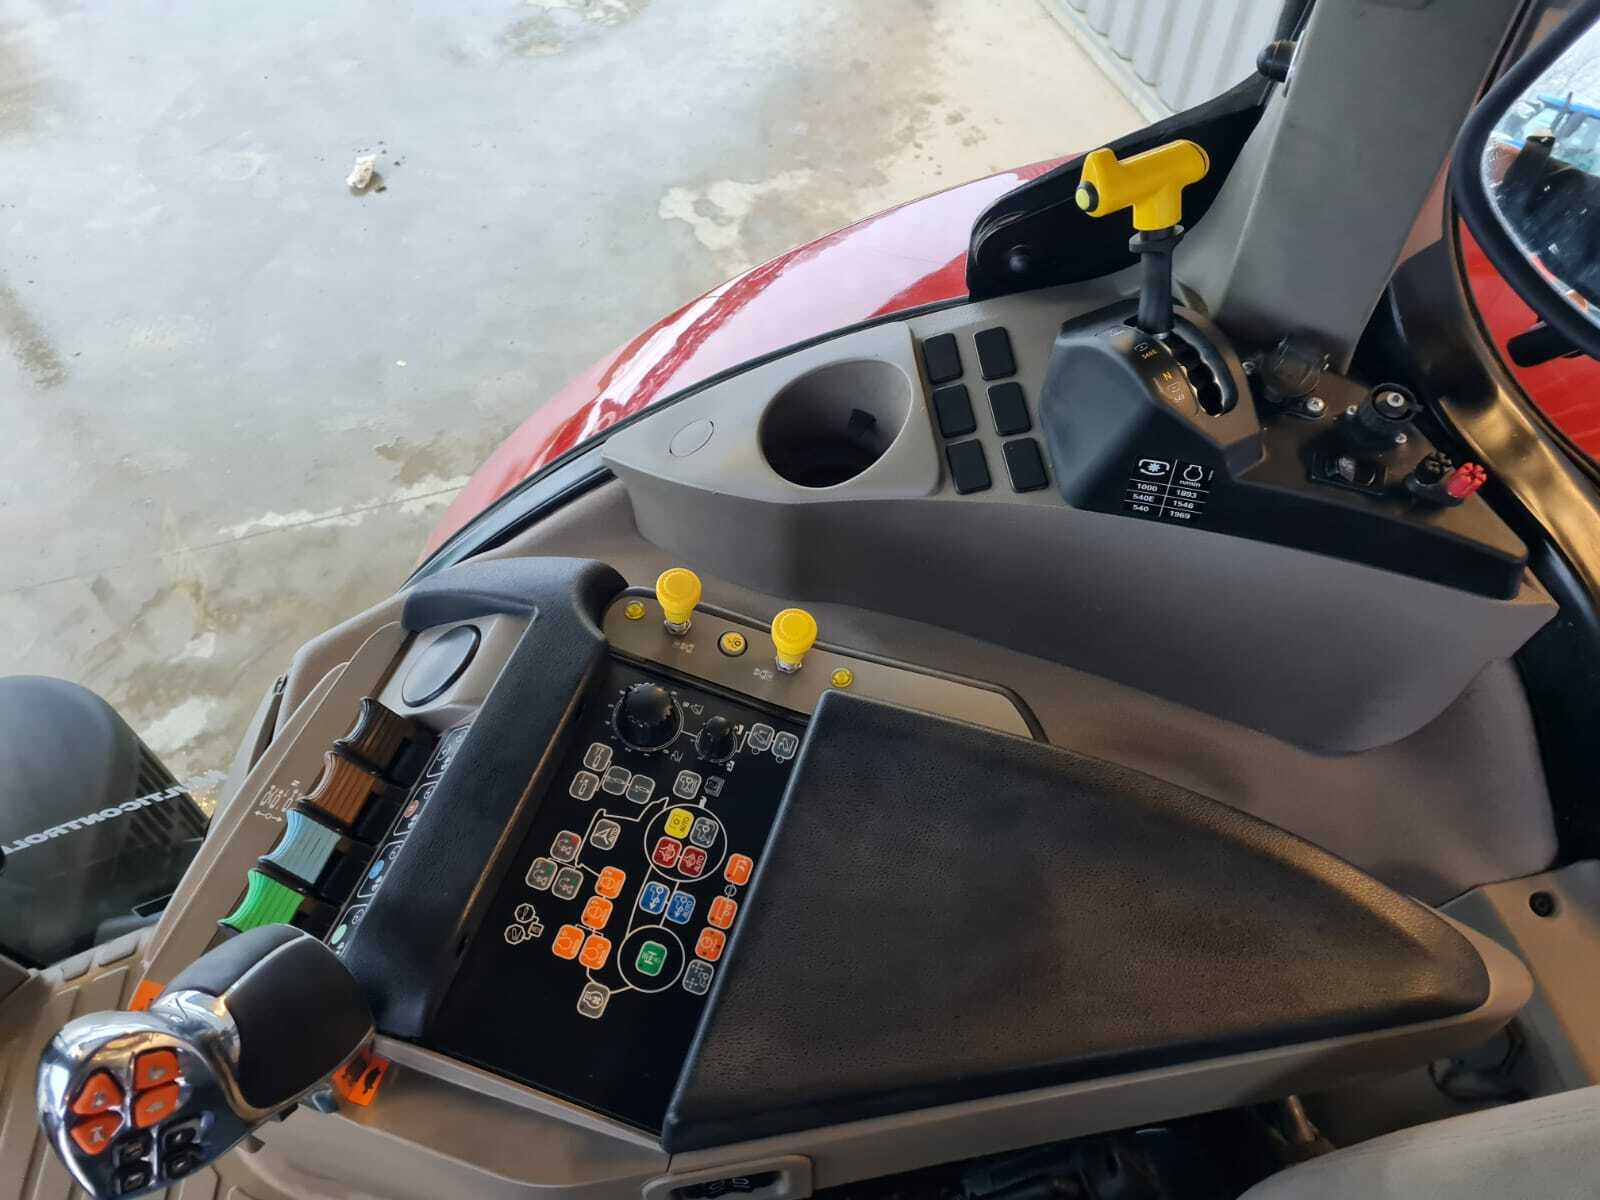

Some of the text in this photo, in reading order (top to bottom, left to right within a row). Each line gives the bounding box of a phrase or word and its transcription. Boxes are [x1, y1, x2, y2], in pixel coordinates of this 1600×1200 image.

[1137, 483, 1158, 492] 1000
[1132, 493, 1195, 509] 540E 1546
[1132, 504, 1150, 512] 540
